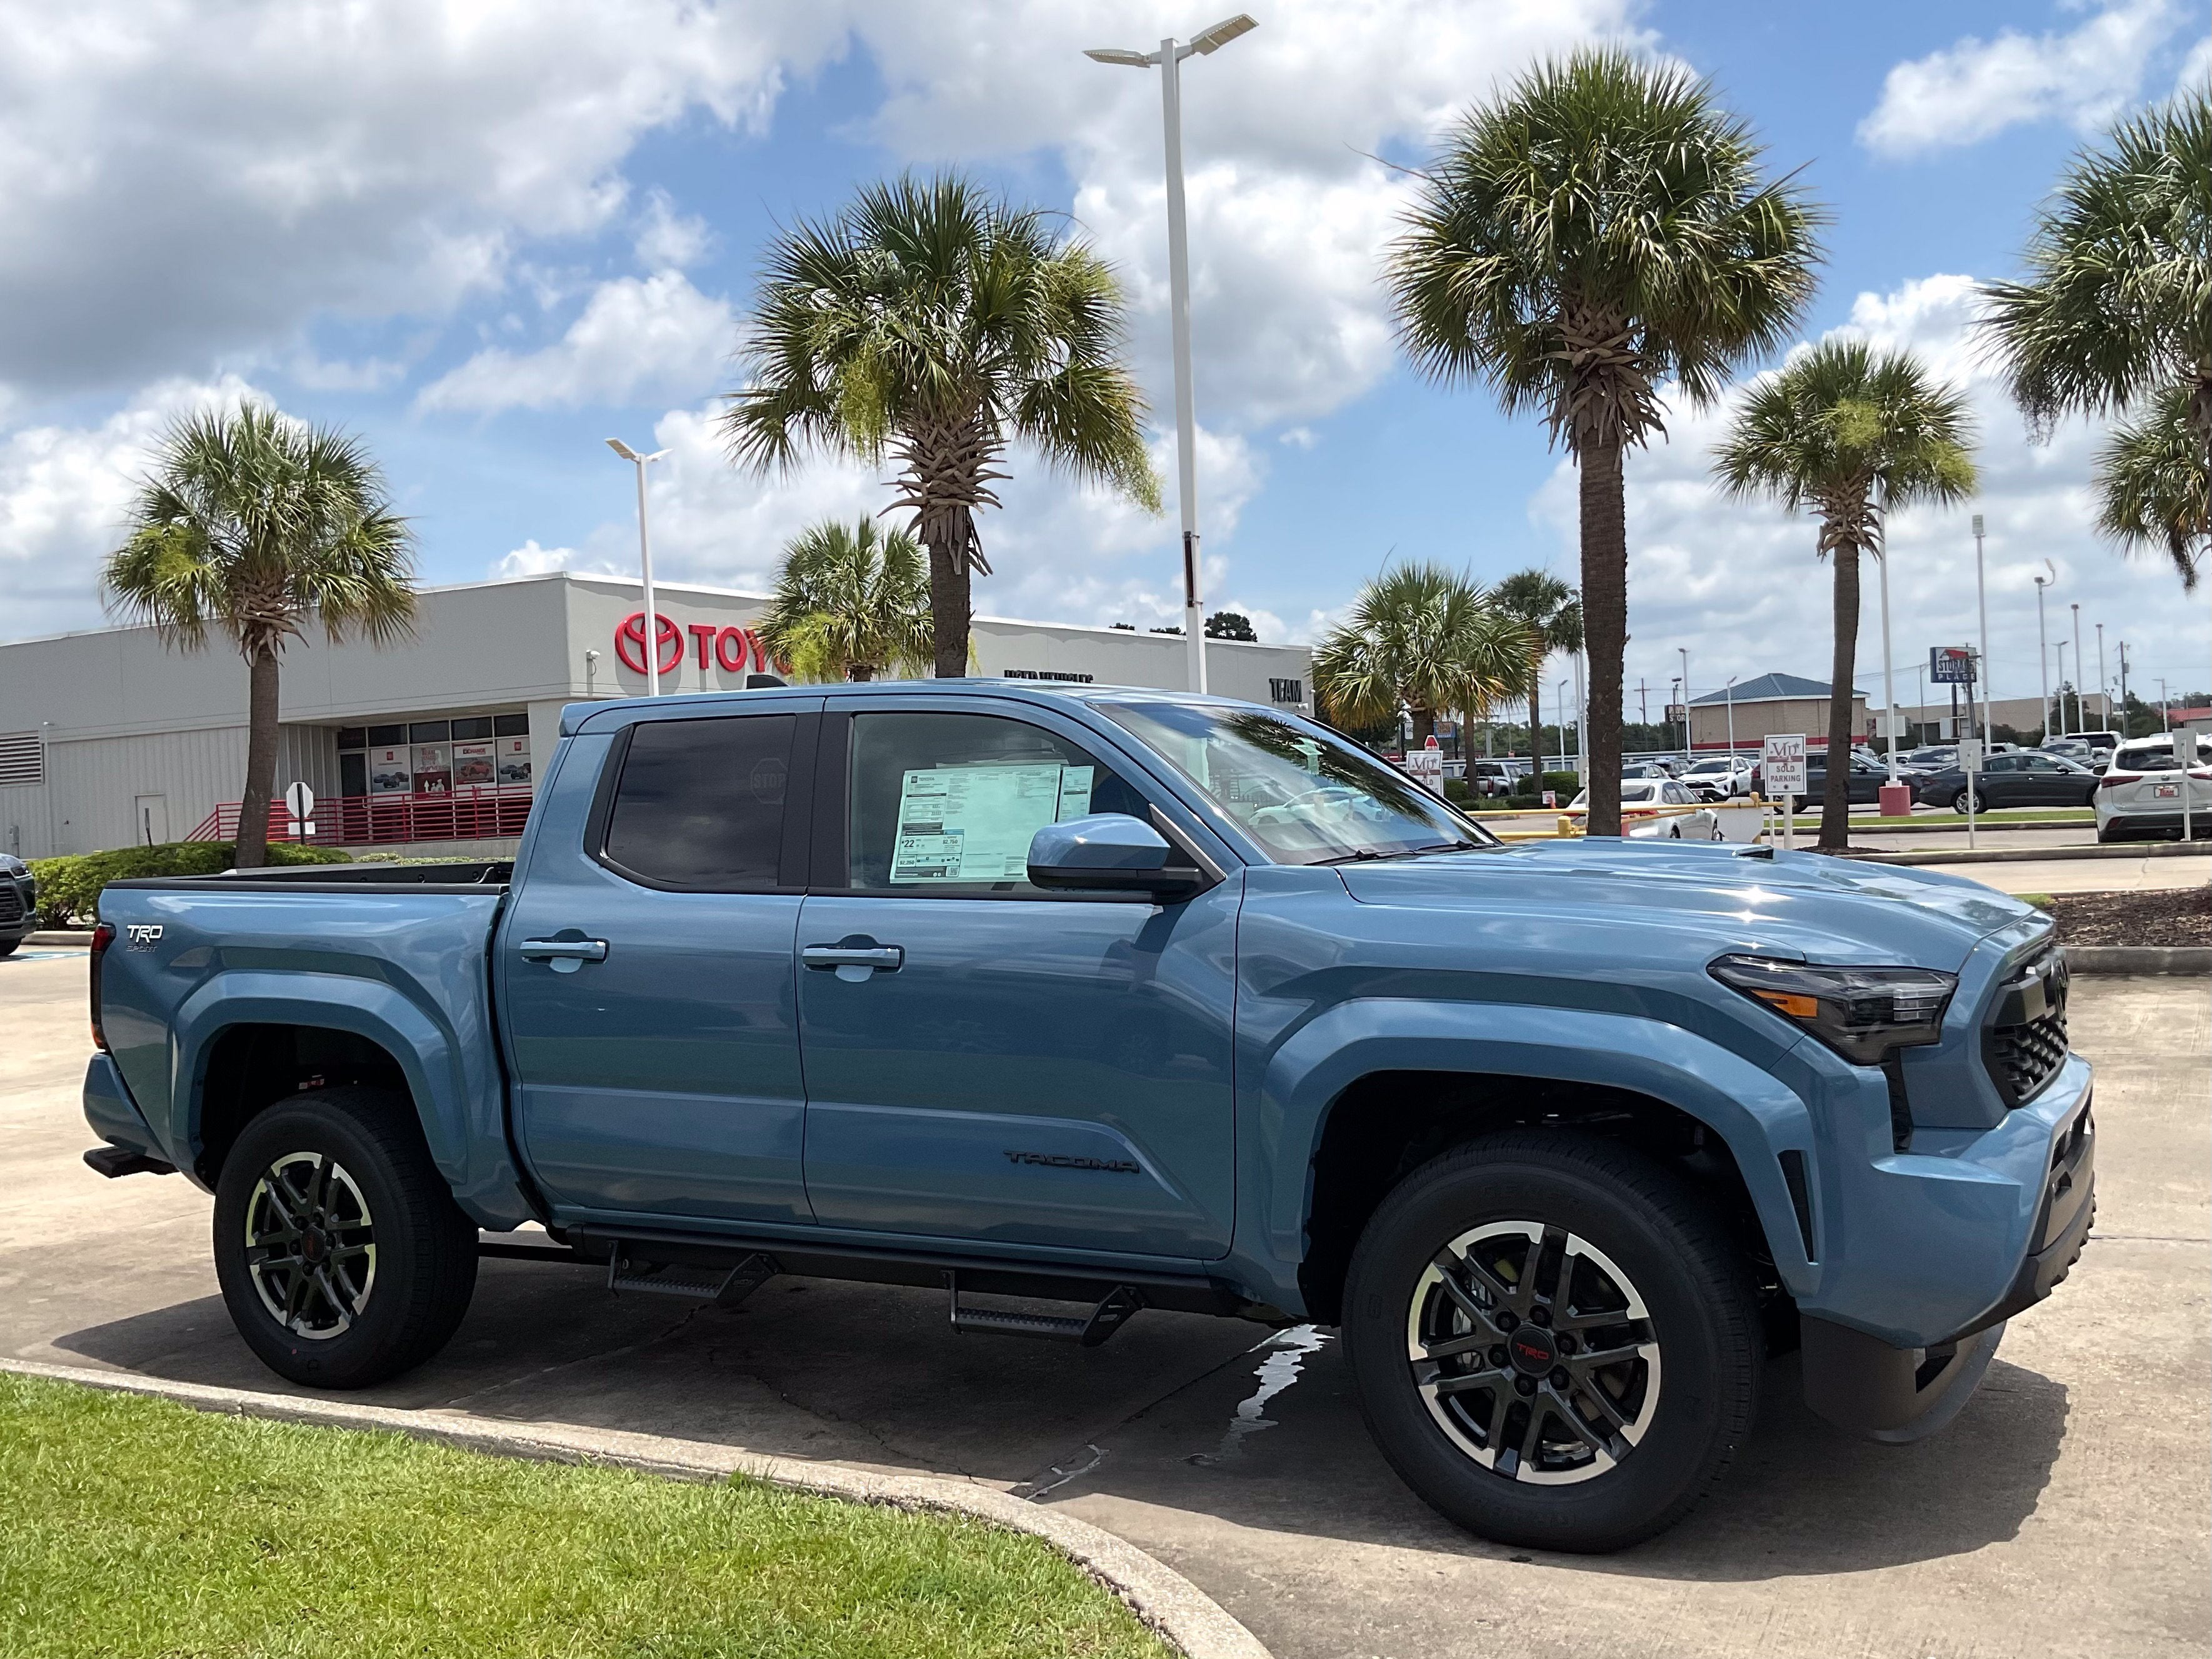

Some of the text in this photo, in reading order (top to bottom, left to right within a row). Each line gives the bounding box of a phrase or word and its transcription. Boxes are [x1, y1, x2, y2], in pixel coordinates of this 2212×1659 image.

[1269, 678, 1302, 702] TEAM
[127, 925, 163, 943] TRD
[1003, 1150, 1139, 1174] TACOMA
[1516, 1343, 1549, 1360] TRD
